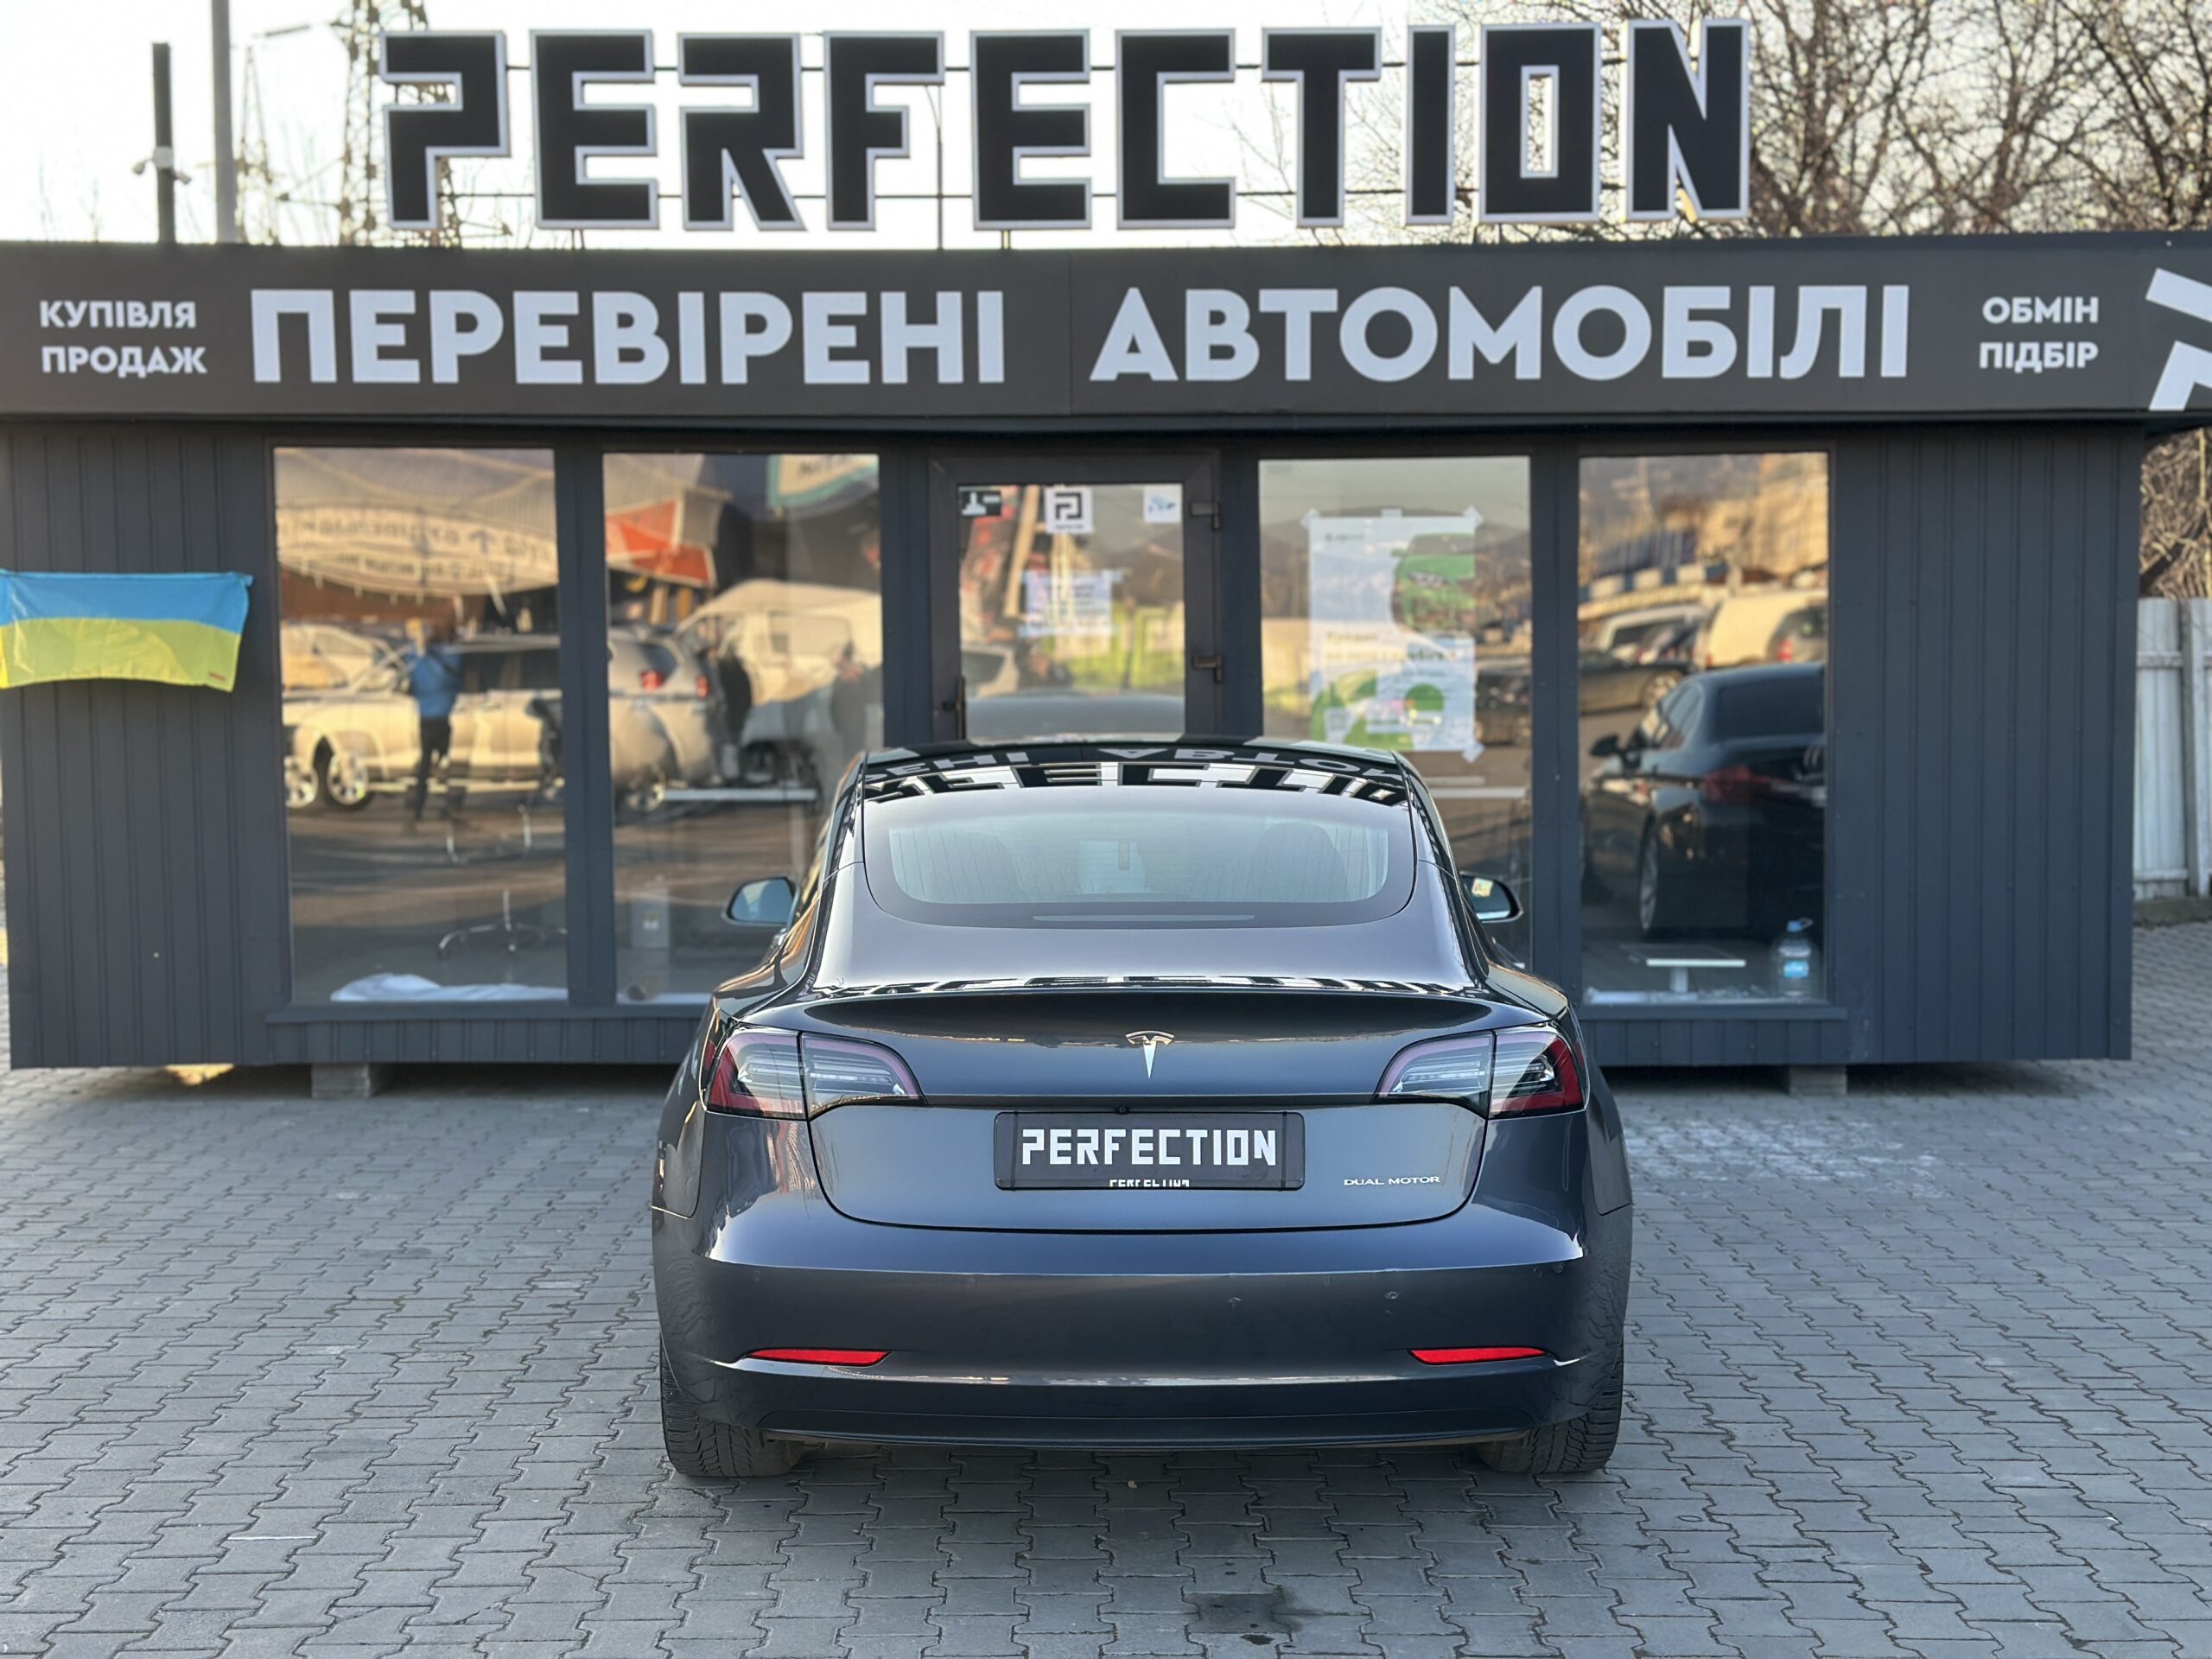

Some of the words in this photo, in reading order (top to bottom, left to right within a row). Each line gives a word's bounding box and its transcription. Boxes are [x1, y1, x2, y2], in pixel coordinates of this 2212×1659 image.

[380, 19, 1751, 232] PERFECTION
[40, 300, 197, 329] КУПІВЛЯ
[1982, 296, 2099, 324] ОБМІН
[251, 289, 1005, 385] ПЕРЕВІРЕНІ
[1089, 285, 1910, 383] АВТОМОБІЛІ
[41, 346, 207, 379] ПРОДАЖ
[1979, 342, 2099, 373] ПІДБІР
[1022, 1128, 1277, 1166] PERFECTION
[1388, 1176, 1440, 1185] MOTOR
